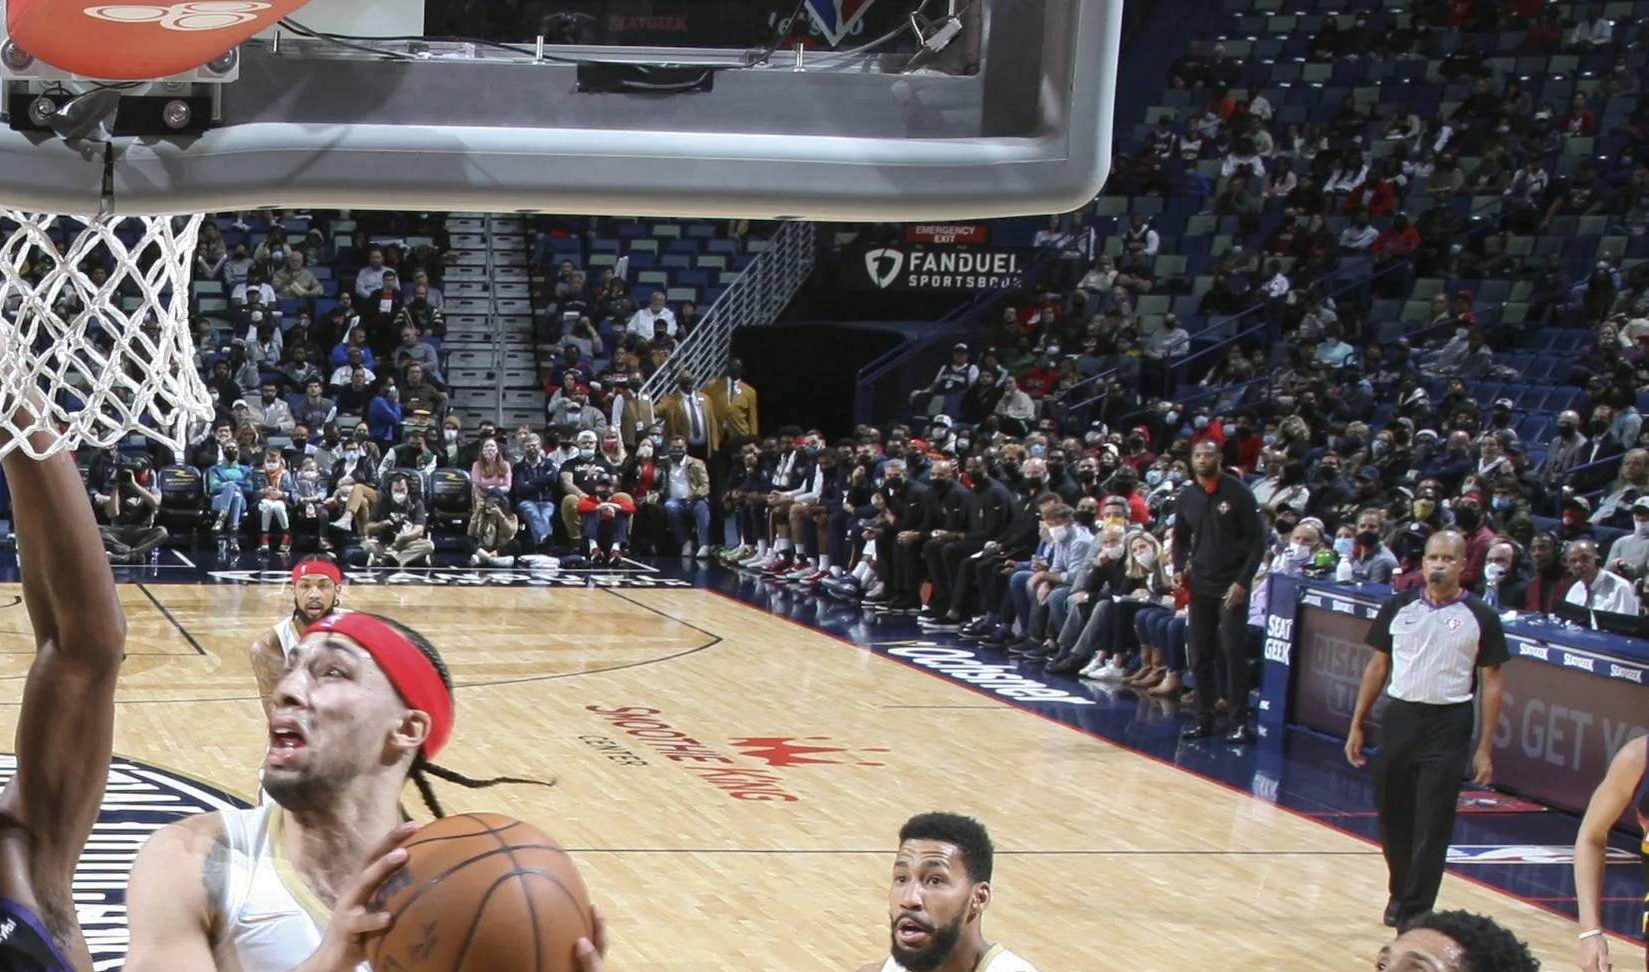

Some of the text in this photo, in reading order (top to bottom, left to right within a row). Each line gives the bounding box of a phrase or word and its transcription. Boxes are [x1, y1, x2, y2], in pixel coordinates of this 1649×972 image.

[916, 225, 975, 235] EMERGENCY
[934, 234, 955, 243] EXIT
[910, 252, 1022, 274] FANDUEL
[1267, 614, 1293, 640] SEAT
[1264, 638, 1292, 666] GEEK
[887, 647, 1097, 705] Ochsner
[1521, 698, 1594, 772] GET
[585, 705, 799, 802] SMOOTHIE KING
